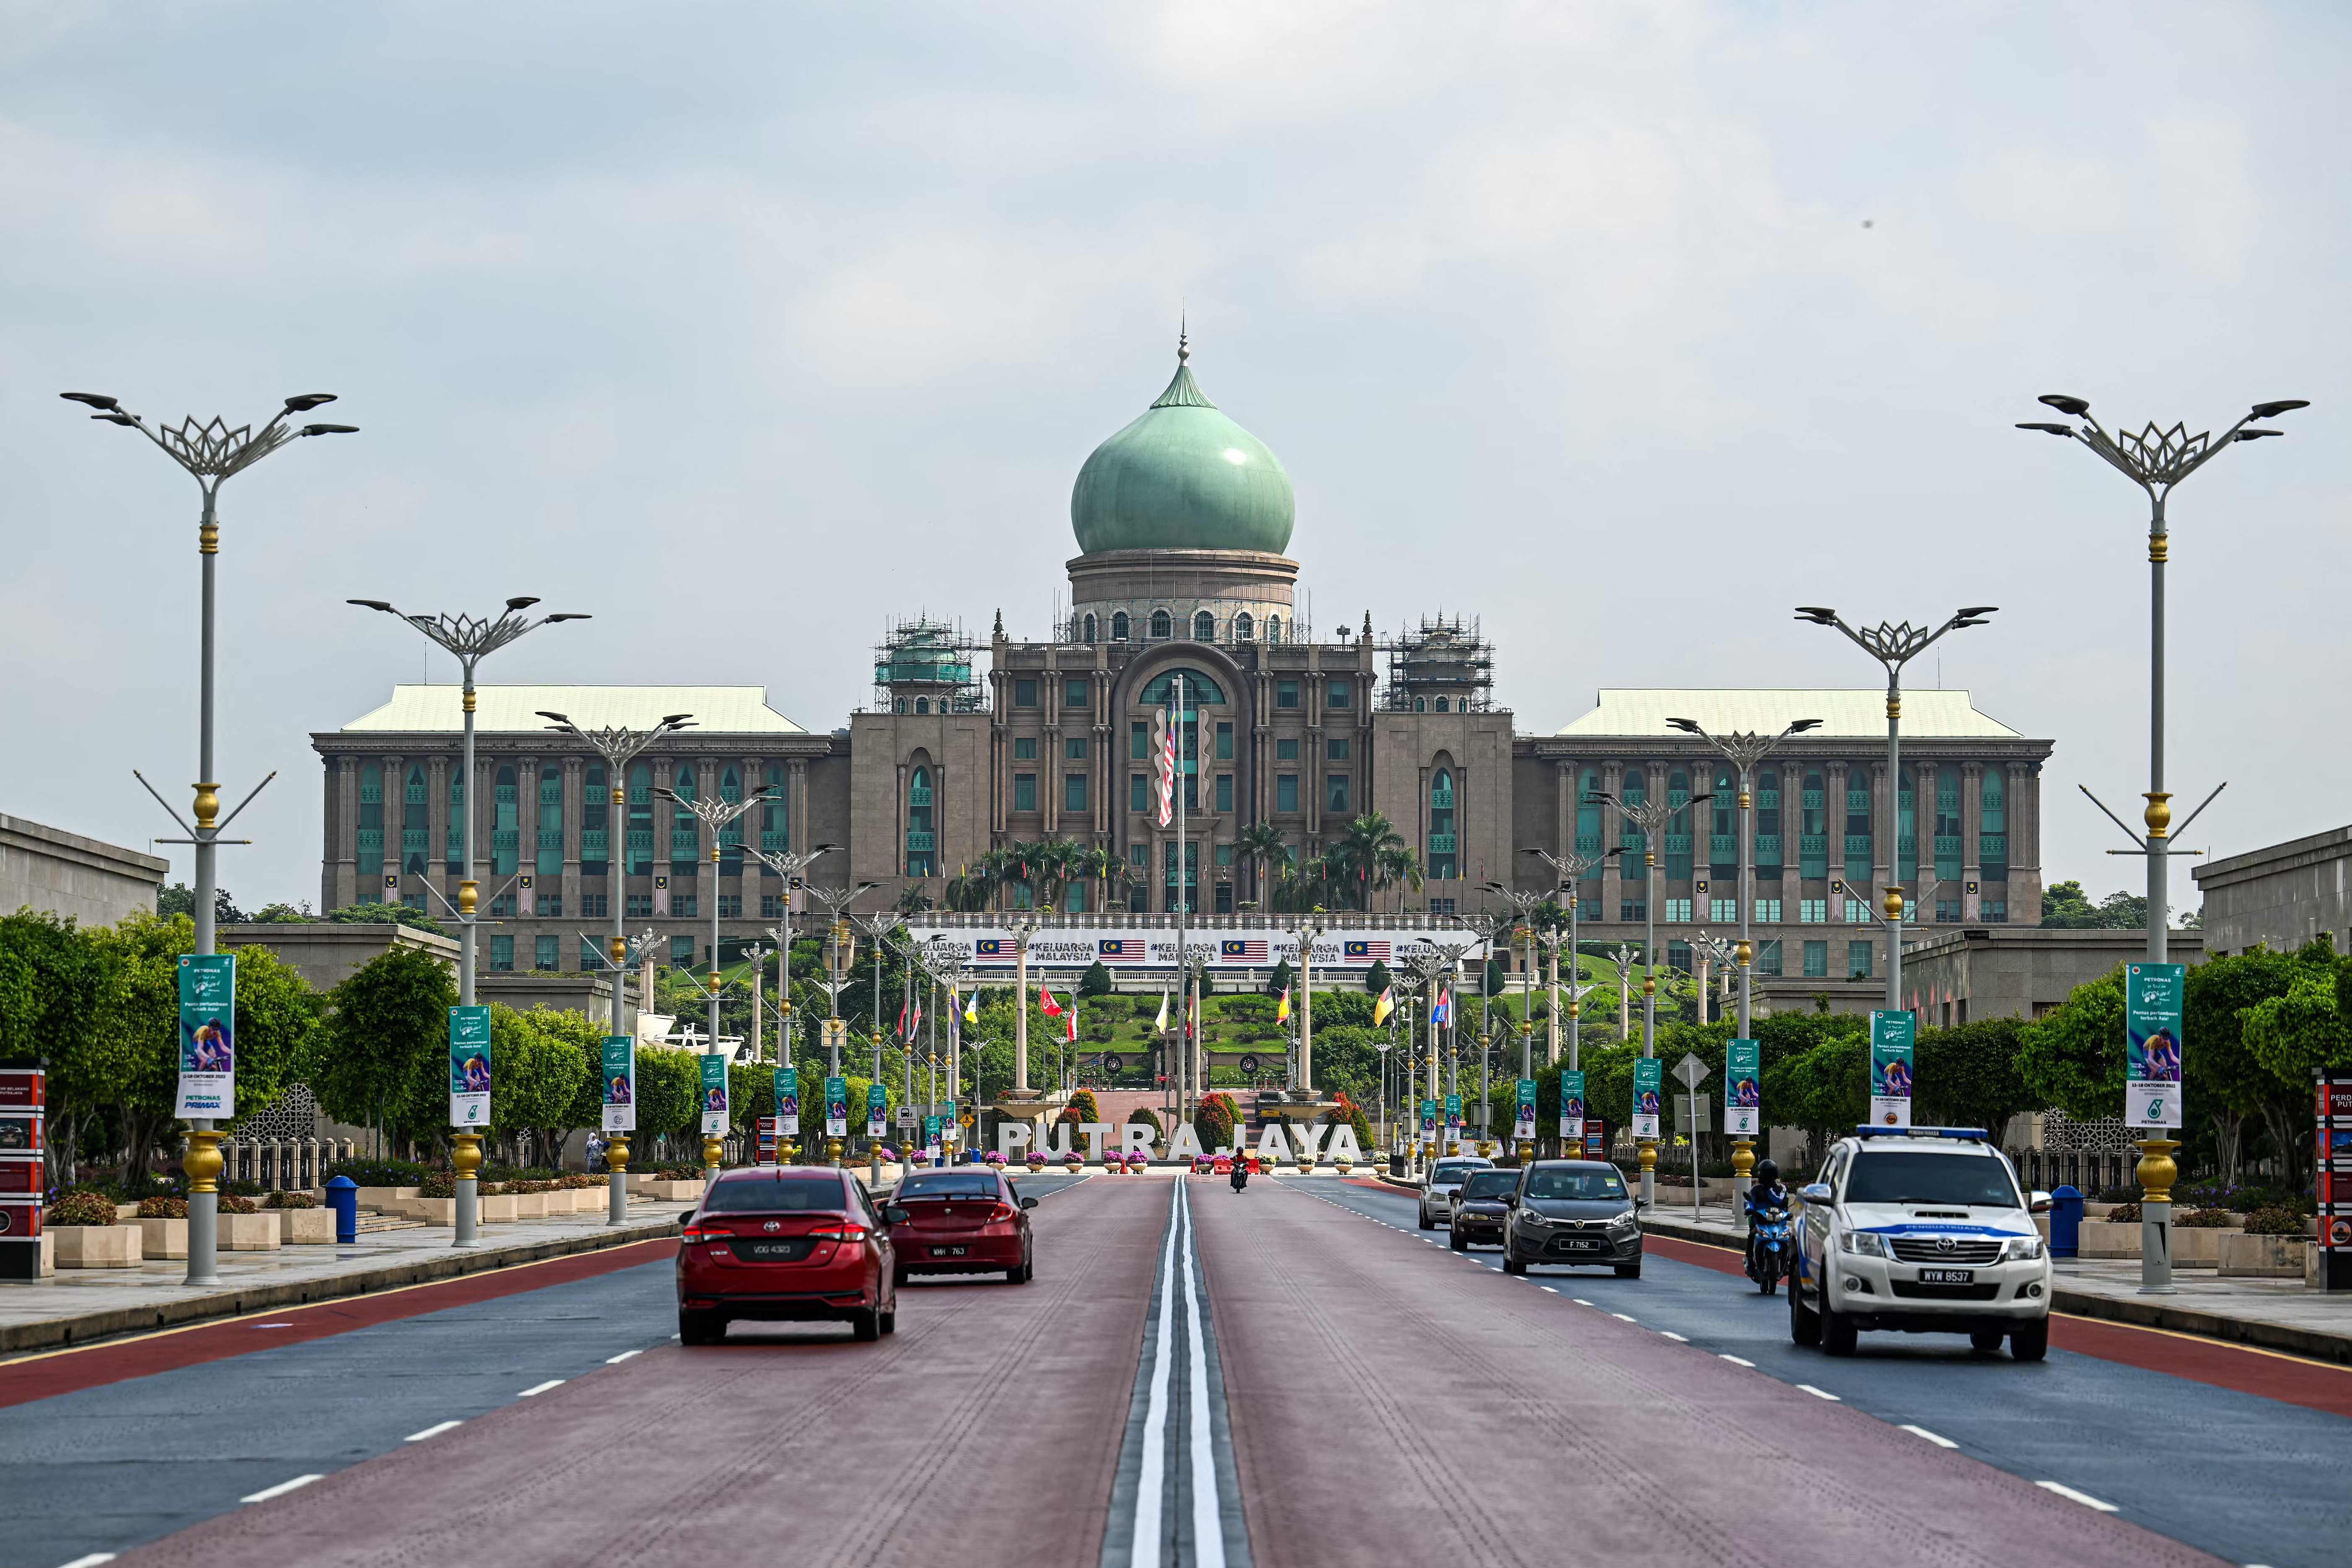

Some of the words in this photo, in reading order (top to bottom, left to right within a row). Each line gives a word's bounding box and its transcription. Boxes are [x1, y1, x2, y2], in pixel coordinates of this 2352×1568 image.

[1028, 943, 1094, 952] #KELUARGA
[1151, 943, 1216, 952] #KELARGA
[1273, 944, 1340, 953] #KELARGA
[998, 1122, 1363, 1162] PUTRAJAYA
[1946, 1272, 1970, 1281] 8537
